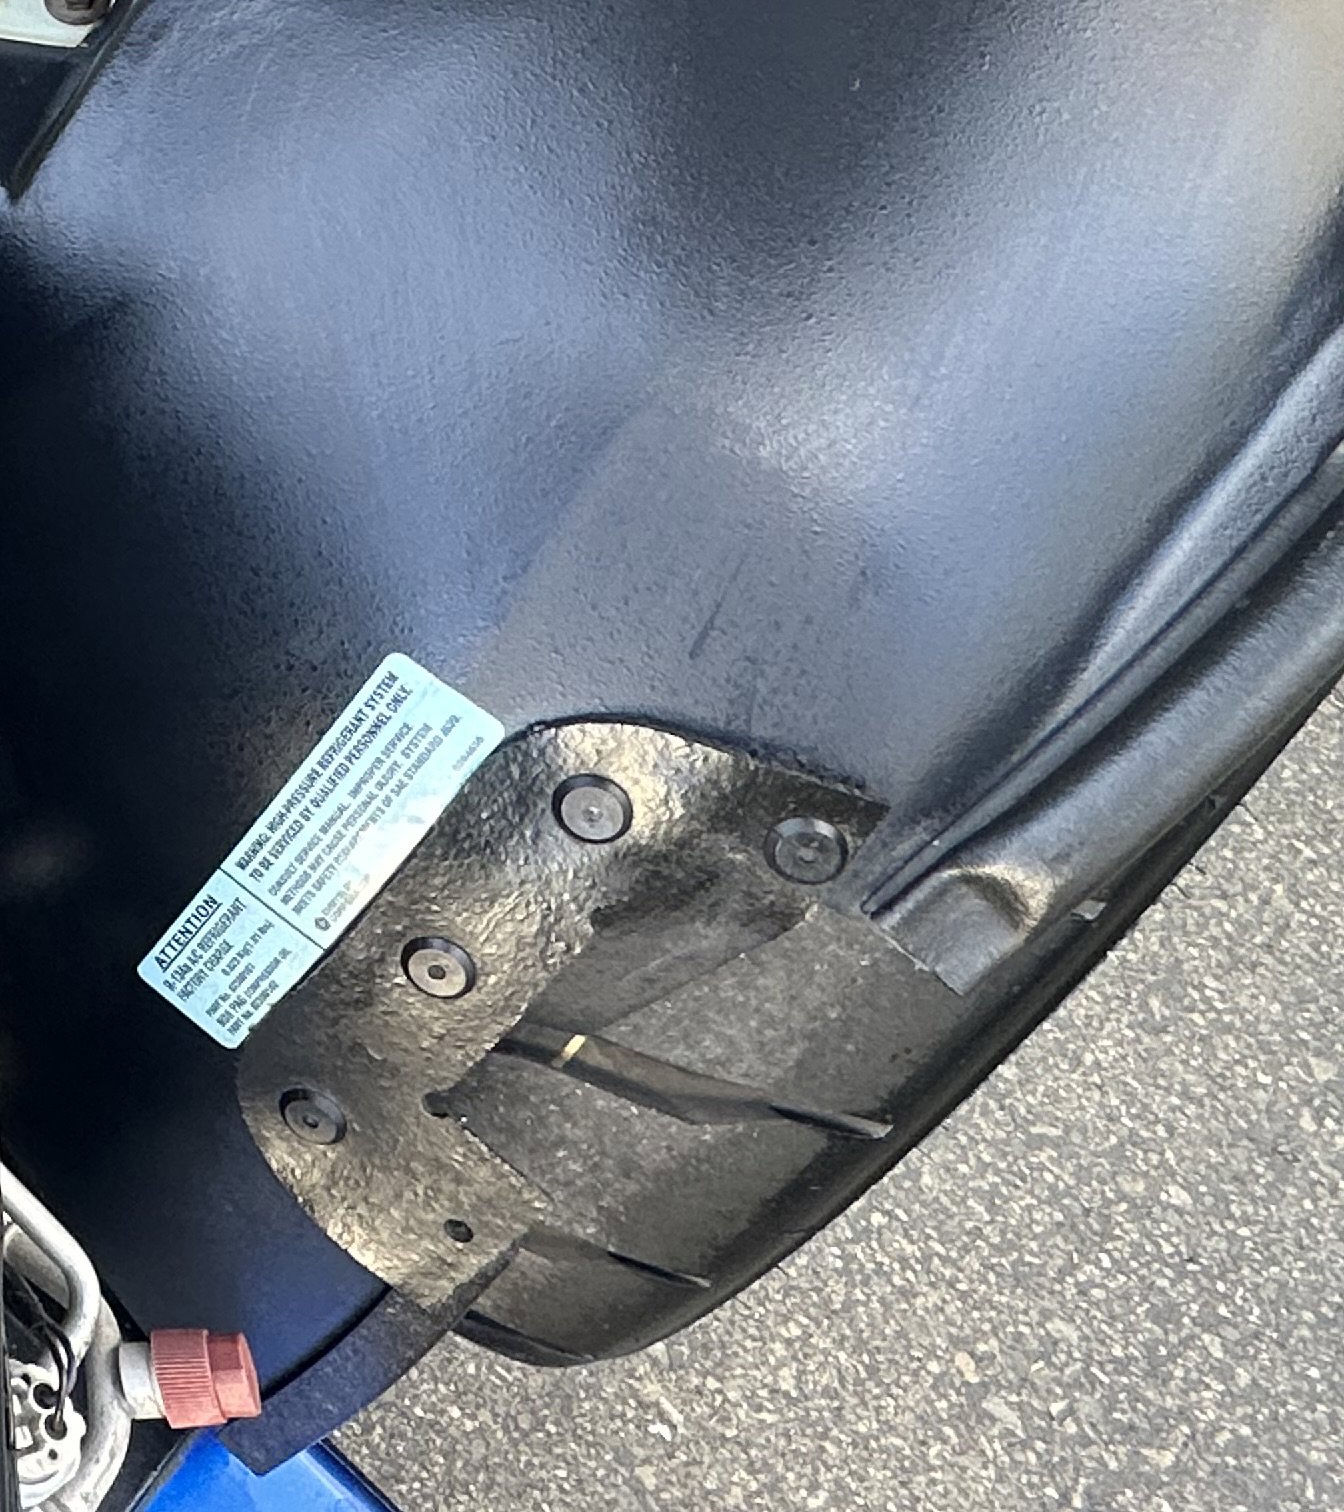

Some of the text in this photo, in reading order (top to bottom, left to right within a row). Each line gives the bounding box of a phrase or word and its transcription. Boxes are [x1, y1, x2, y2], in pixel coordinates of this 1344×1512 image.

[317, 708, 369, 770] REFRIGERANT
[363, 671, 399, 711] SYSTEM
[248, 868, 264, 883] TO
[298, 805, 315, 822] BY
[310, 762, 350, 808] QUALIFIED
[344, 713, 392, 765] PERSONNEL
[155, 895, 217, 971] ATTENTION
[197, 897, 246, 953] REFRIGERANT
